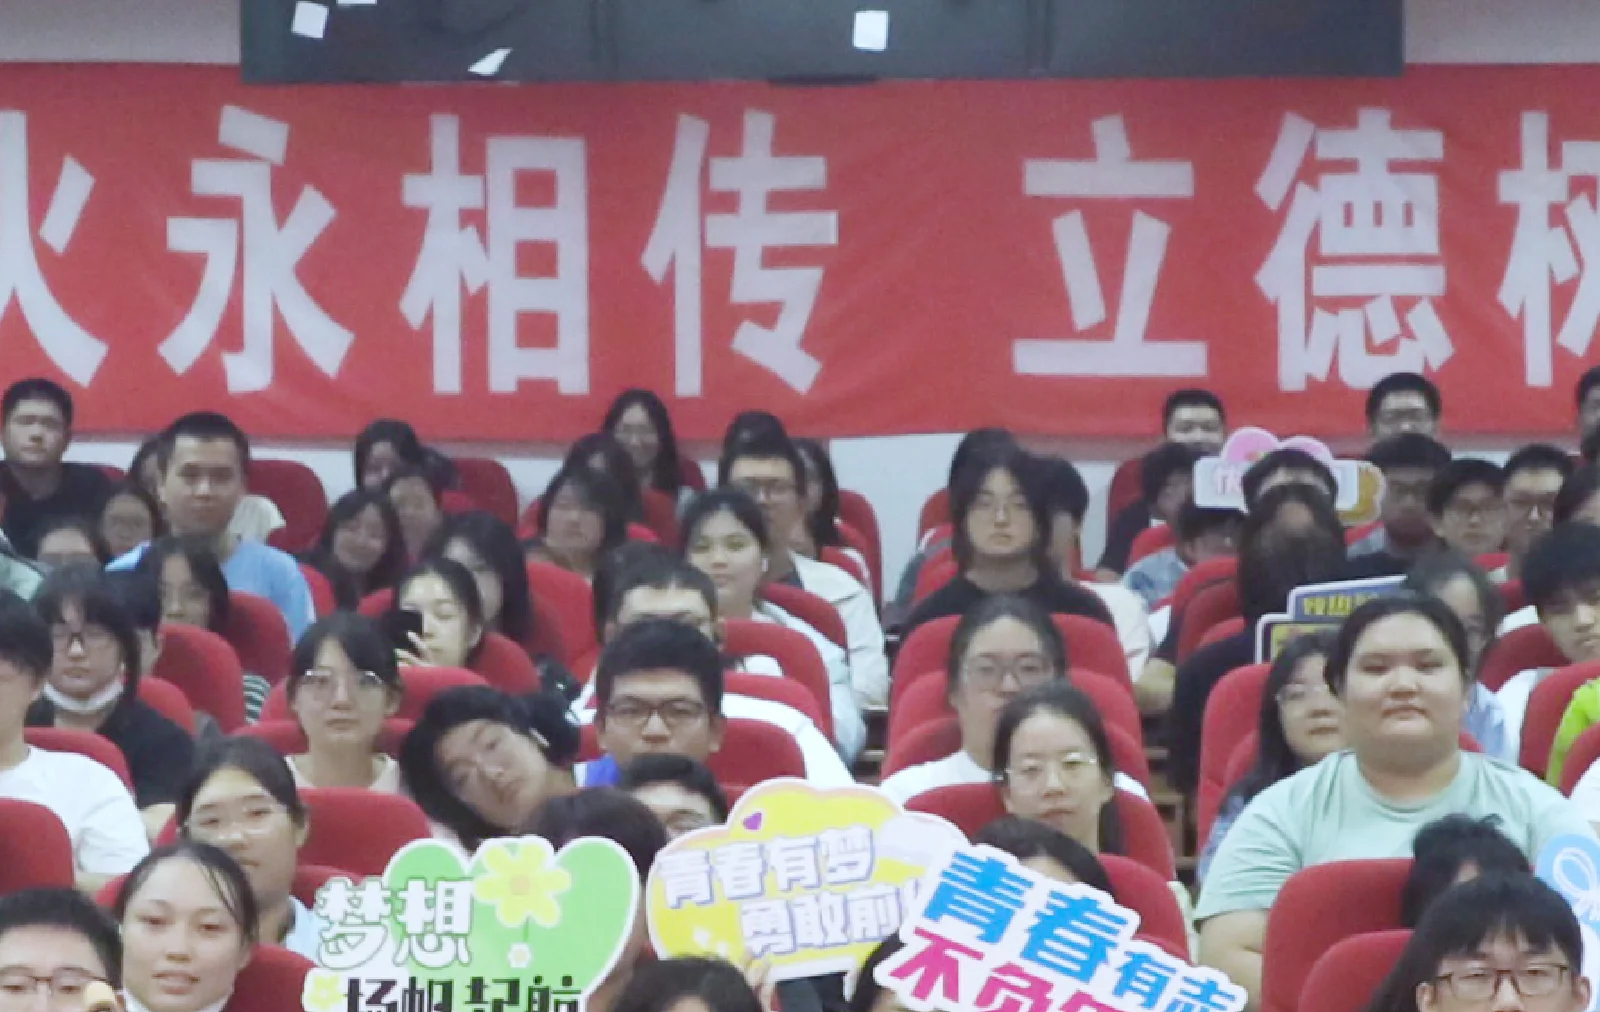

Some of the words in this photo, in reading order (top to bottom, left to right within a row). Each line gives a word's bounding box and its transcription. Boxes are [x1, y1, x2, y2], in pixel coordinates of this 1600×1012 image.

[659, 826, 874, 910] 青春有梦
[315, 876, 474, 969] 梦想
[742, 879, 921, 957] 勇敢前
